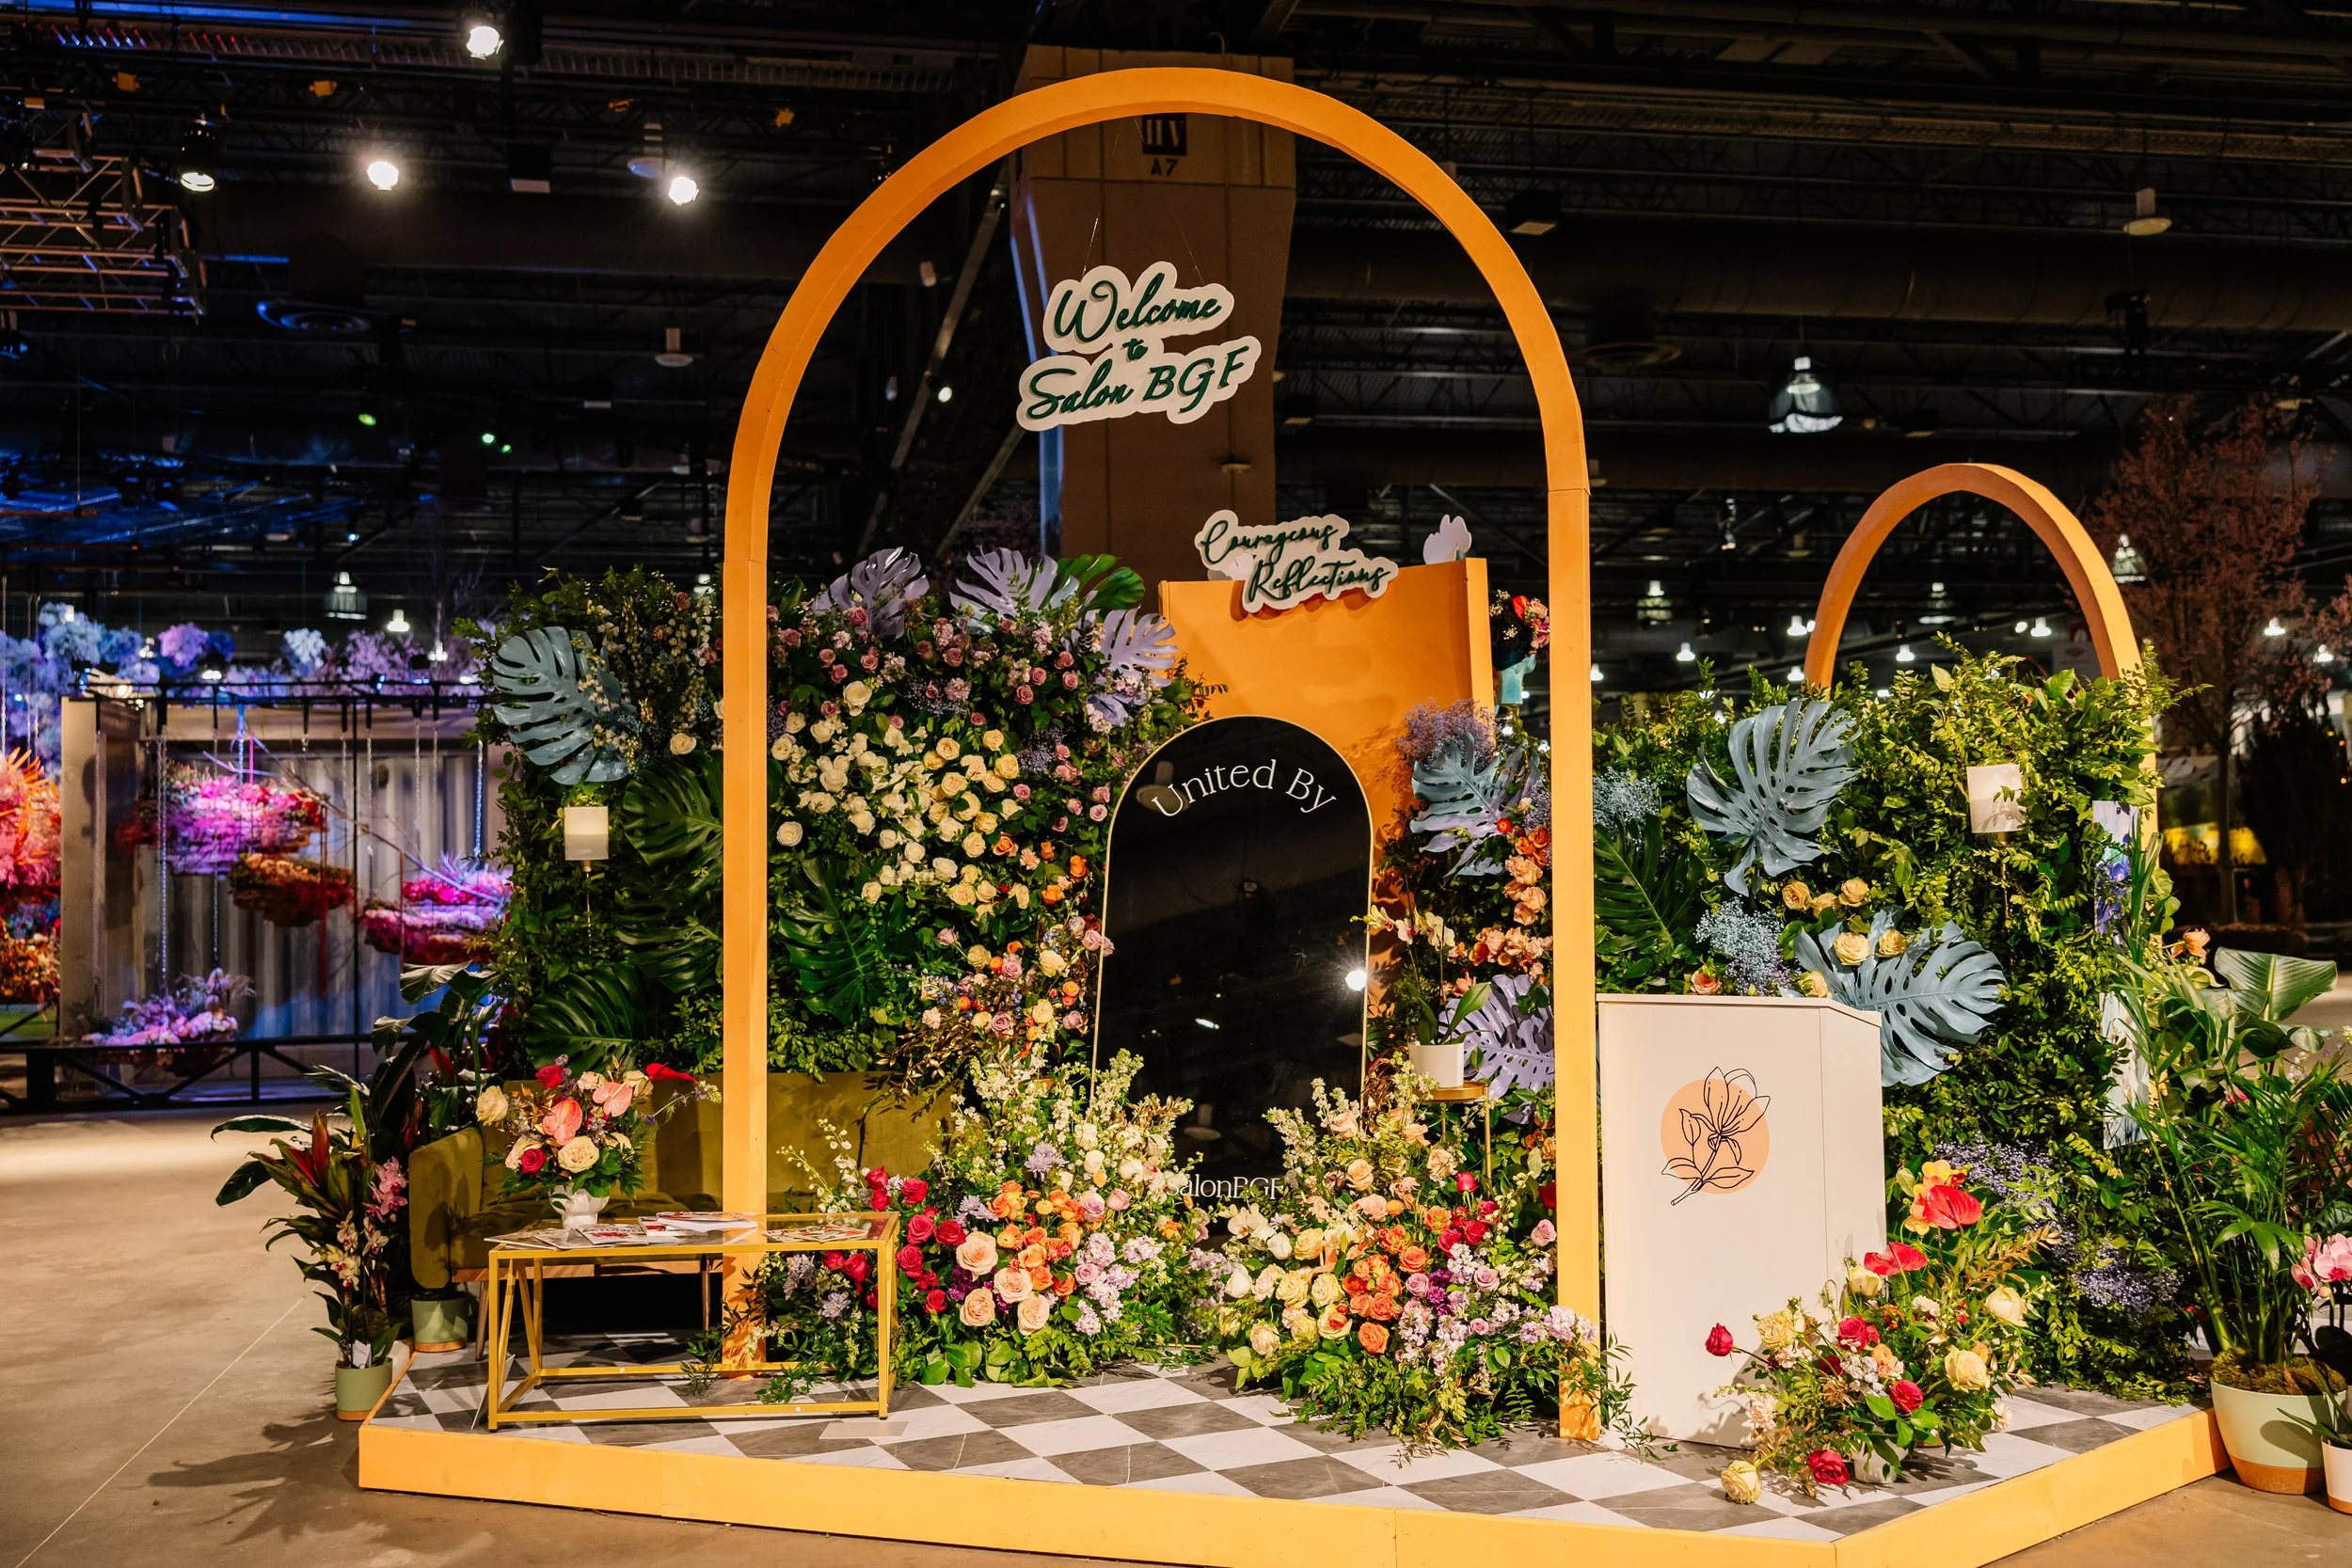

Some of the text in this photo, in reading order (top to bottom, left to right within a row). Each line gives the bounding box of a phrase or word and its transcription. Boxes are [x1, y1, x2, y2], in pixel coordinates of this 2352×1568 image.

[1151, 157, 1178, 177] A7
[1054, 272, 1222, 342] Welcome
[1122, 337, 1148, 361] to
[1026, 345, 1249, 420] Salon BGF
[1200, 519, 1340, 564] Courageous
[1248, 555, 1391, 602] Reflections
[1151, 758, 1337, 817] United By
